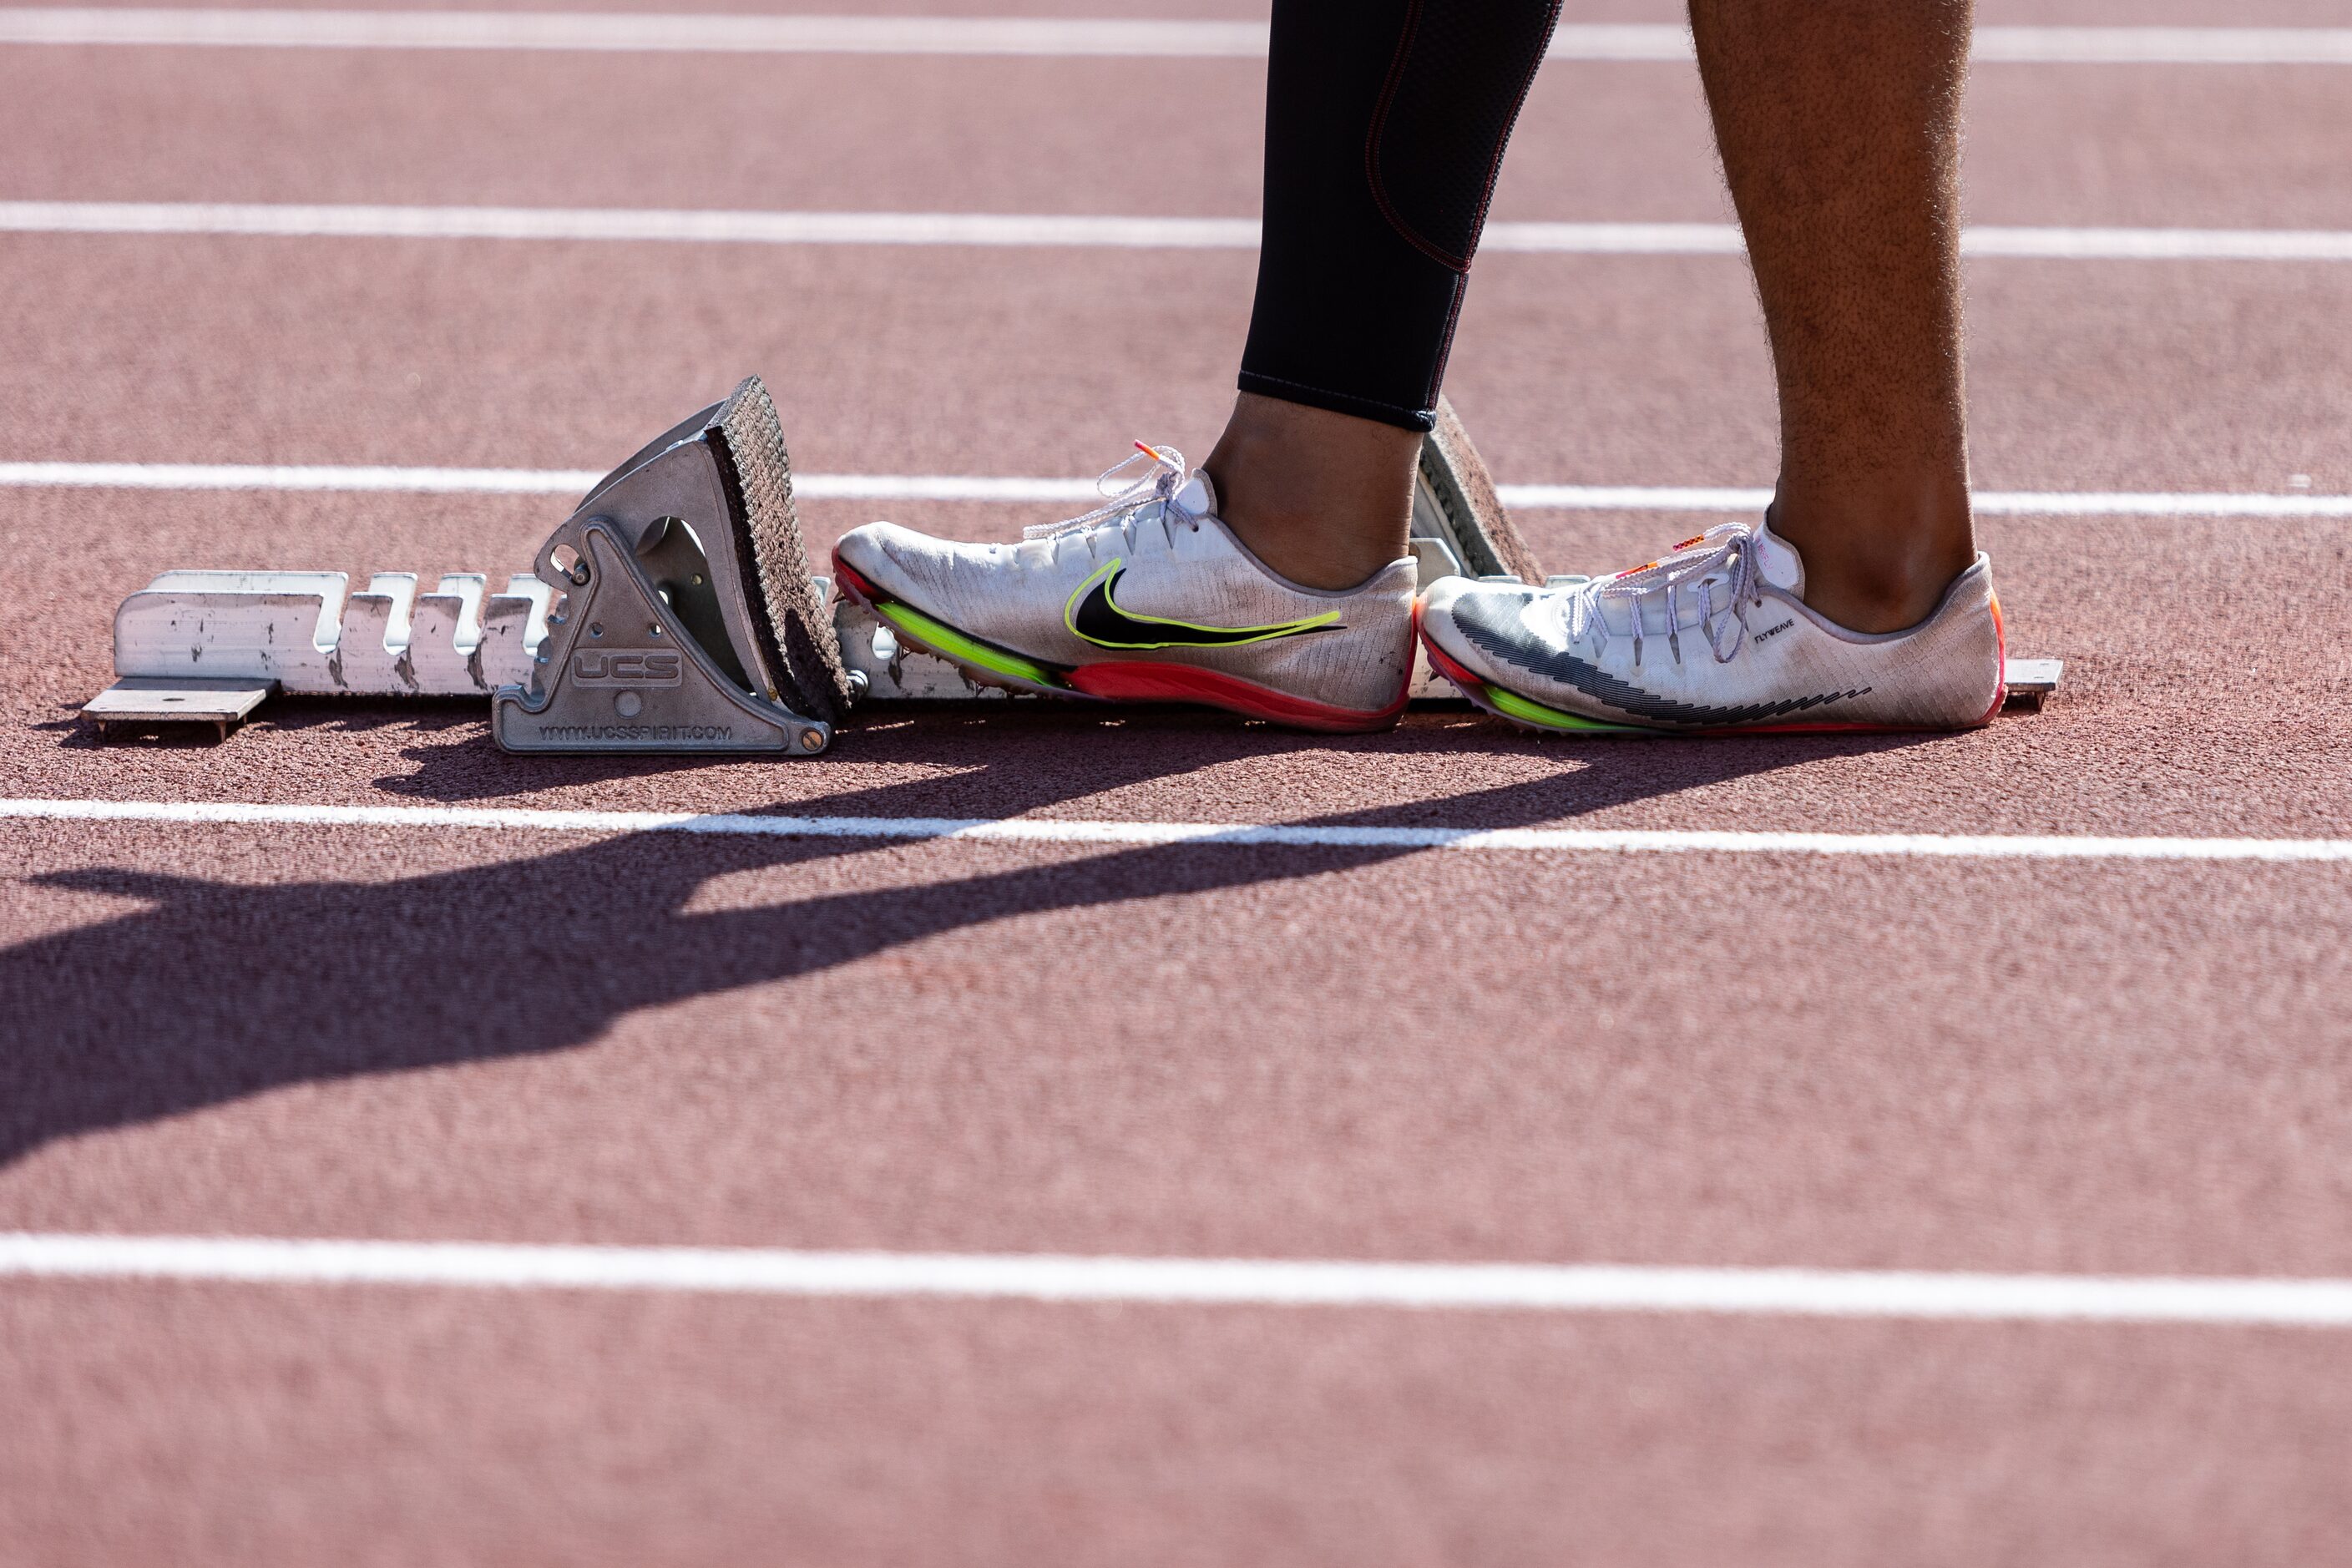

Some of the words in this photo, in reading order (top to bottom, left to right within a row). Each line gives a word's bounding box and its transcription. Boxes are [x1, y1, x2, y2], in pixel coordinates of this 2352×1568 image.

[1754, 619, 1794, 644] FLYWEAVE
[574, 655, 679, 679] UCS
[539, 726, 732, 741] WWW.UCSSPIRIT.COM
